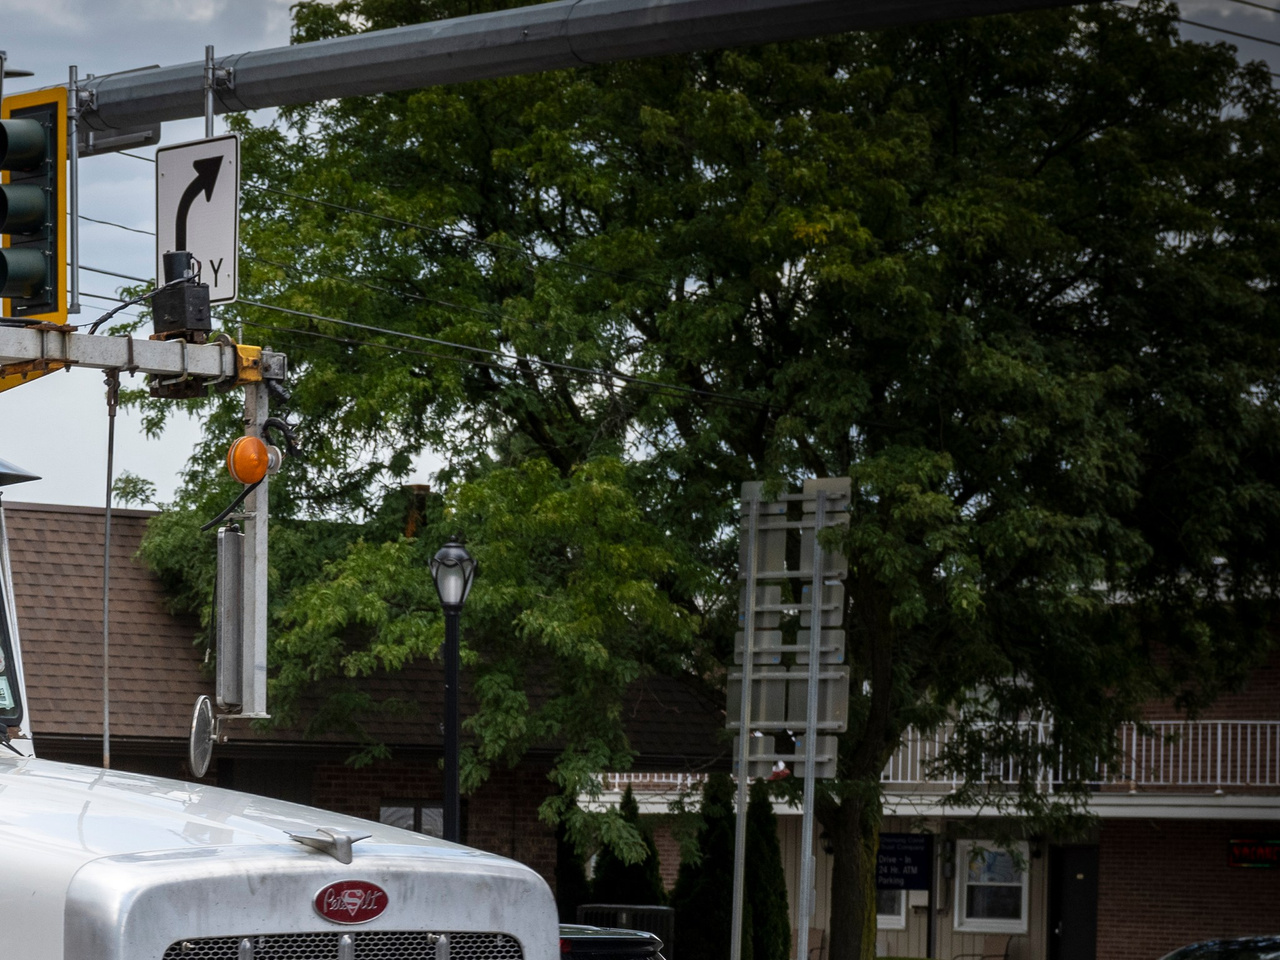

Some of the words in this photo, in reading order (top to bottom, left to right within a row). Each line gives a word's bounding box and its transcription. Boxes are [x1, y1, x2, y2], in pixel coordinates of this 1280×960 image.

[879, 855, 896, 863] Drive
[902, 865, 918, 874] ATM
[878, 876, 904, 886] Parking
